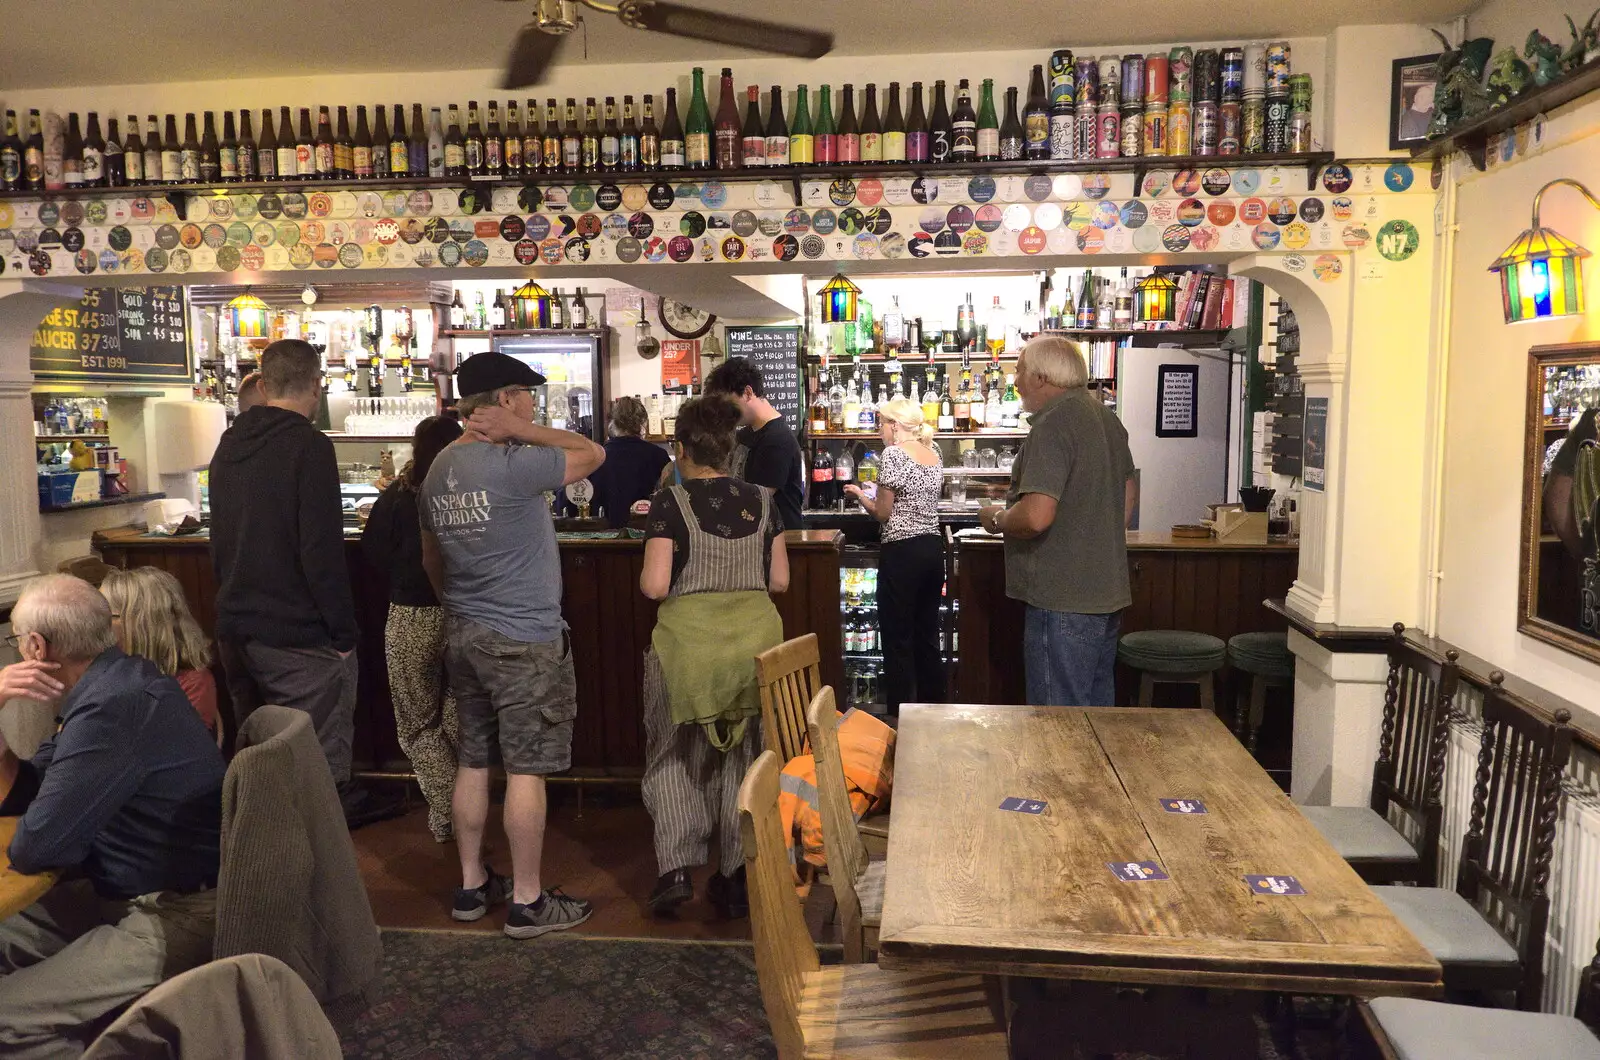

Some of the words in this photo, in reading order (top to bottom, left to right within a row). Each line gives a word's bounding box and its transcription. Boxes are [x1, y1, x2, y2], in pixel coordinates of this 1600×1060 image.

[1382, 234, 1408, 254] N7
[122, 294, 142, 308] GOLD
[40, 307, 62, 326] GE
[64, 309, 80, 328] ST.
[124, 328, 142, 340] SIPA
[730, 331, 753, 341] WINE
[663, 343, 691, 351] UNDER
[663, 350, 677, 359] 25?
[81, 355, 104, 368] EST.
[107, 356, 126, 369] 1991
[433, 506, 492, 527] HOBDAY
